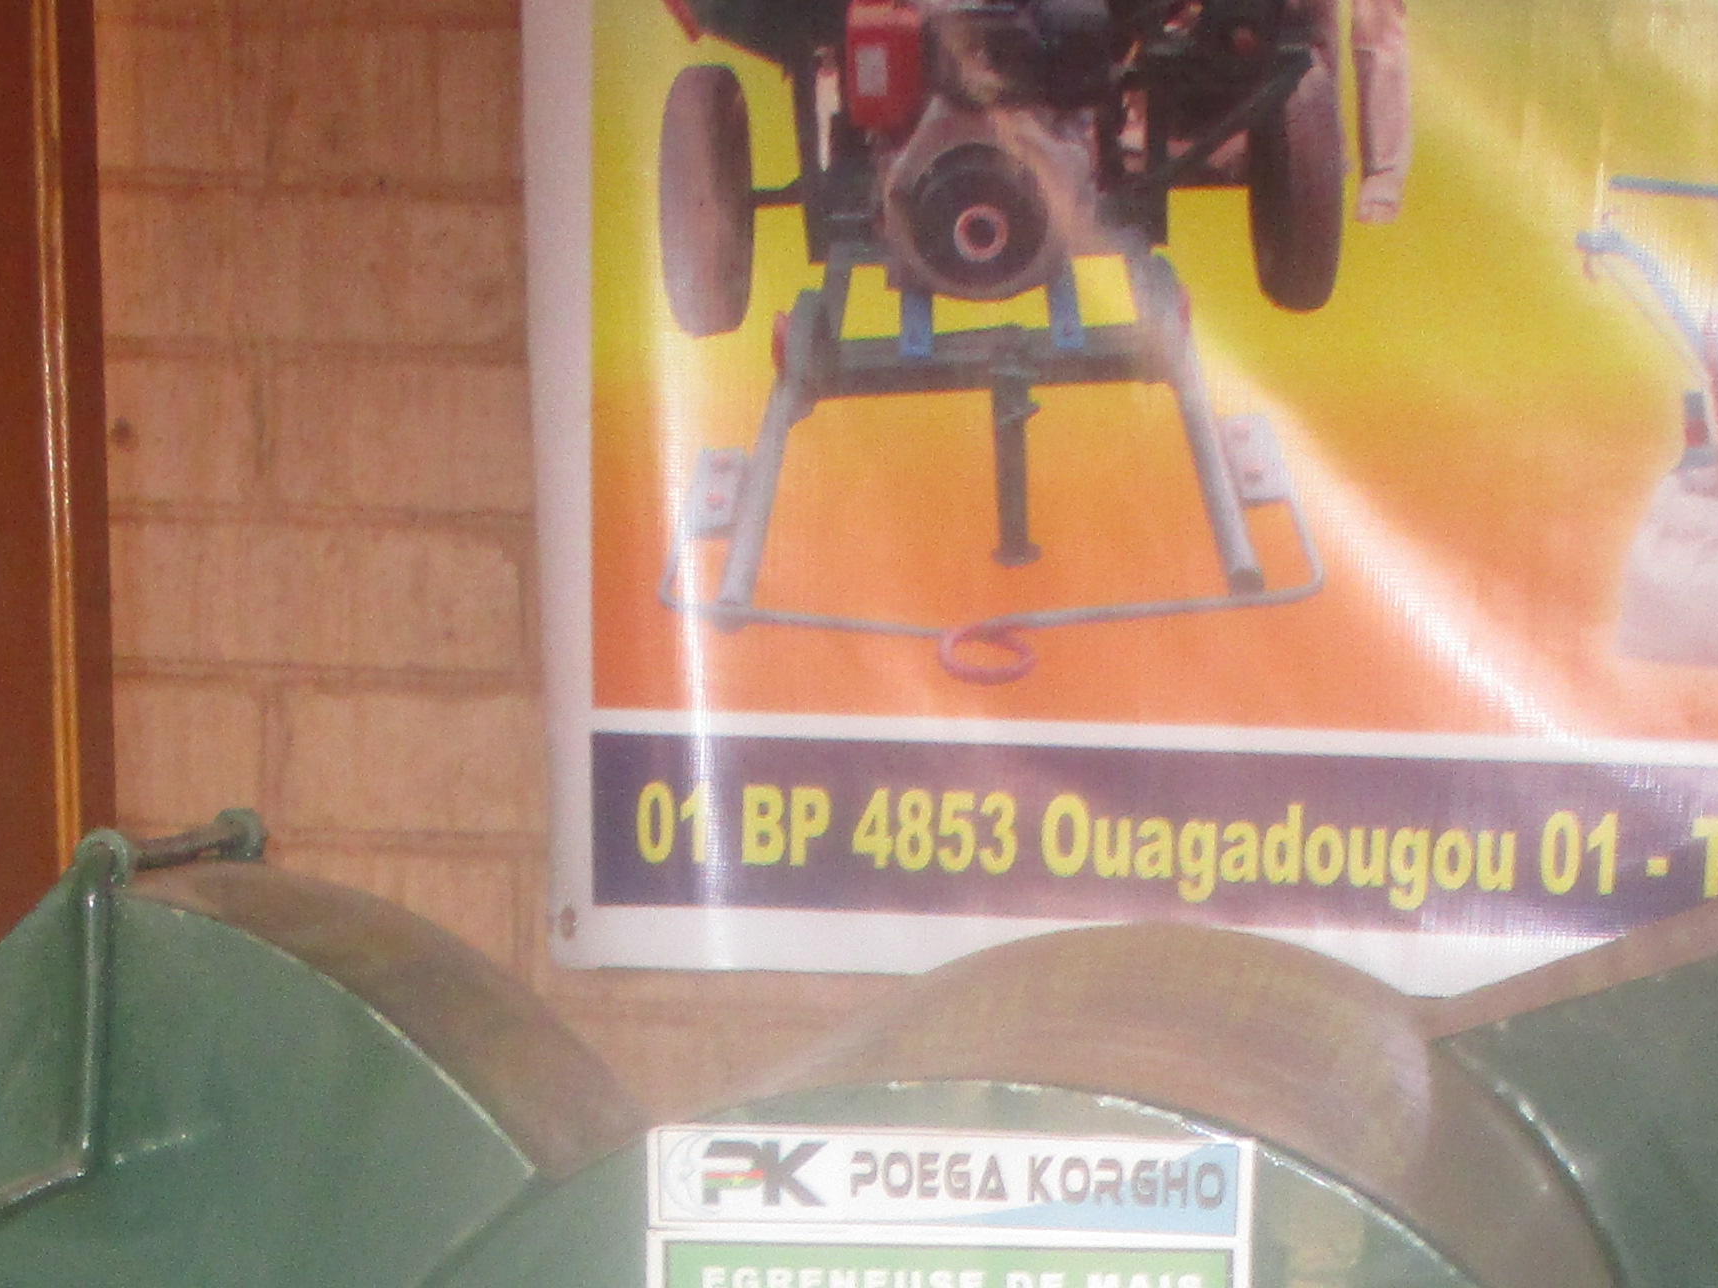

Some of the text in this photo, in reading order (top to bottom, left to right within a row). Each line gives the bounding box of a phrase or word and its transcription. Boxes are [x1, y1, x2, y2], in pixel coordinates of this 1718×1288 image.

[636, 782, 705, 864] 01
[742, 786, 831, 868] BP
[852, 787, 1018, 874] 4853
[1039, 794, 1516, 911] Ouagadougou
[1543, 810, 1619, 896] 01
[849, 1150, 1009, 1203] POEGA
[1028, 1157, 1226, 1211] KORGHO
